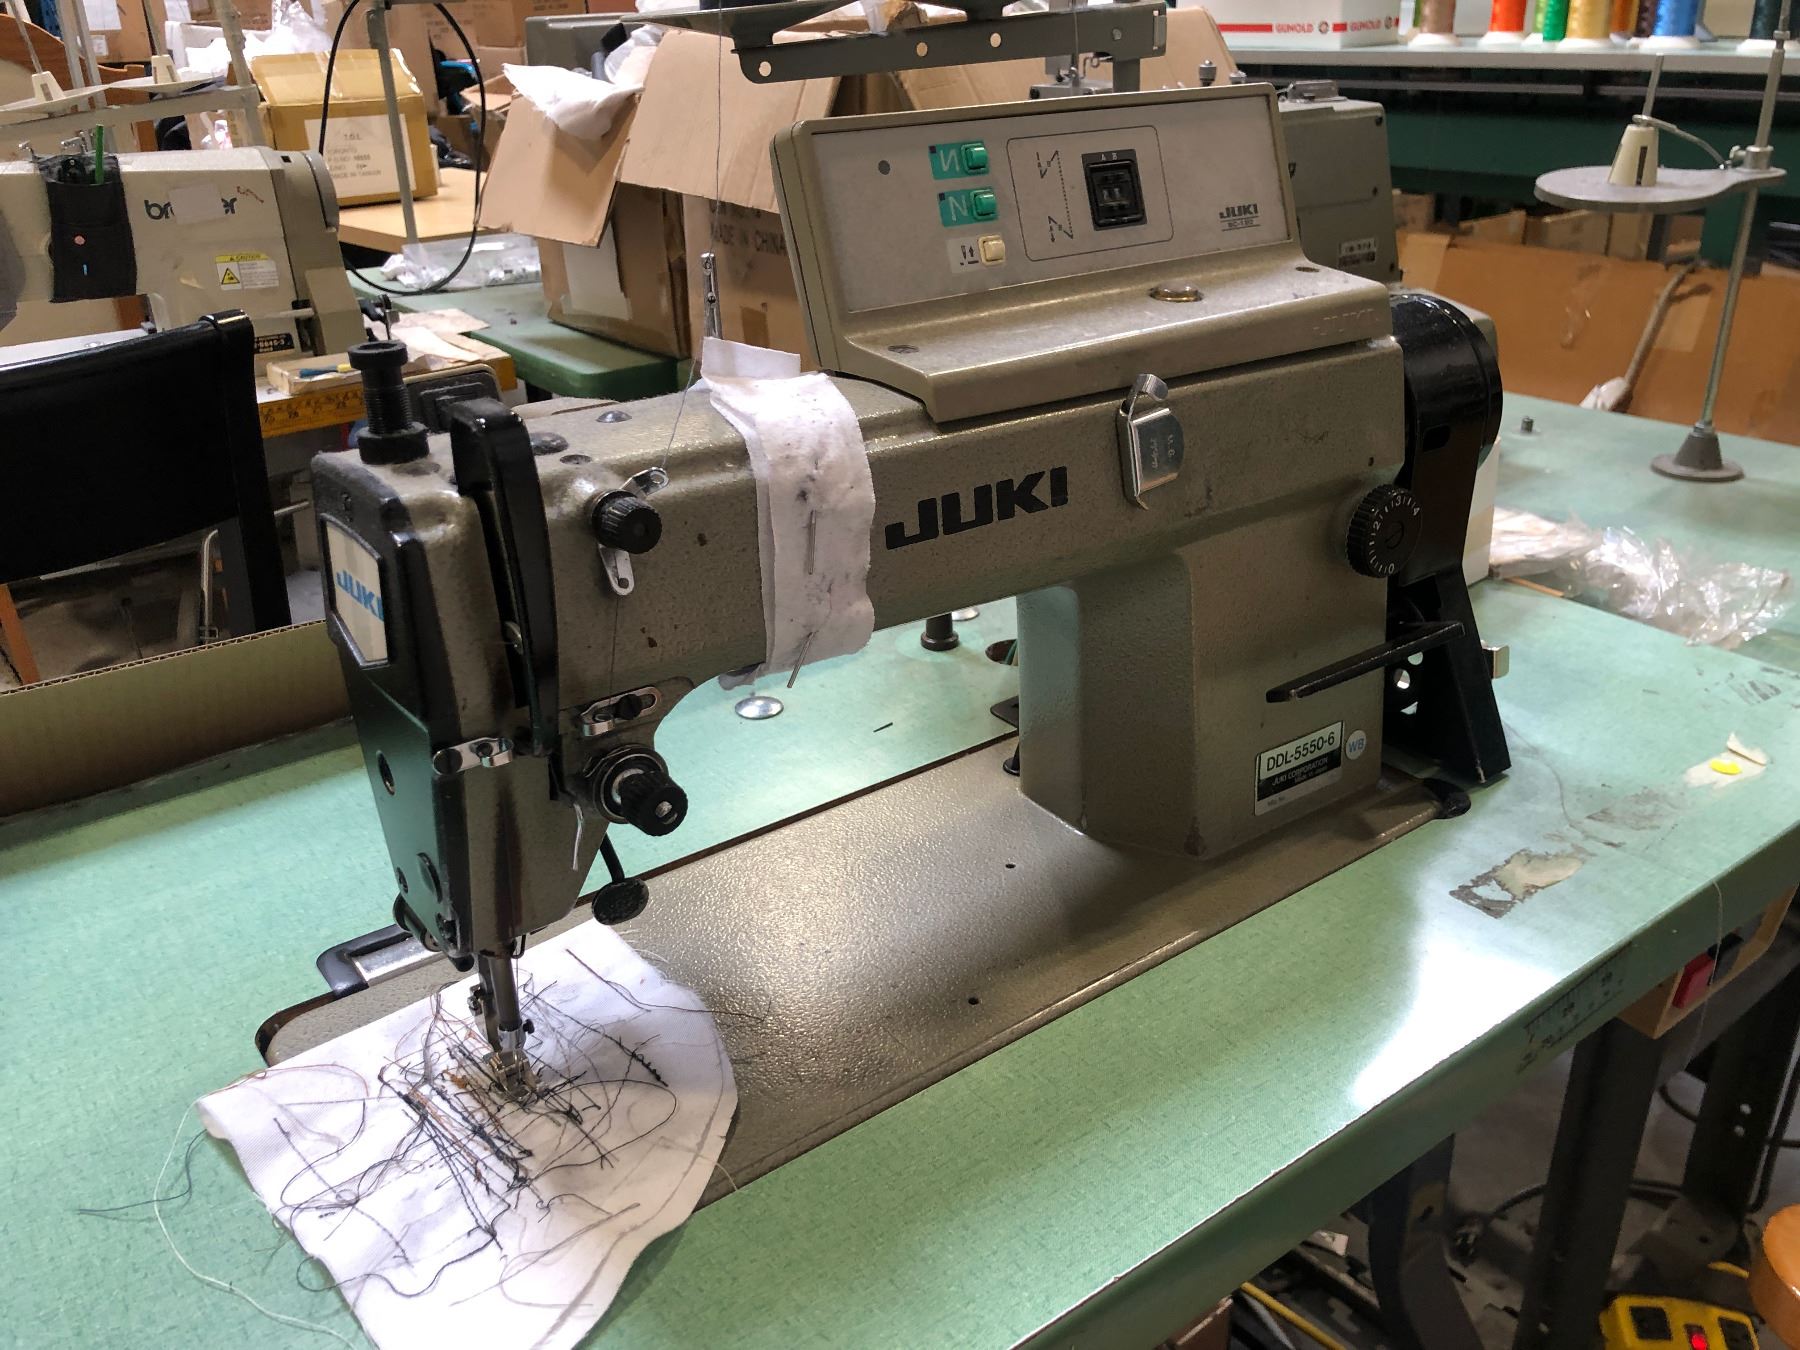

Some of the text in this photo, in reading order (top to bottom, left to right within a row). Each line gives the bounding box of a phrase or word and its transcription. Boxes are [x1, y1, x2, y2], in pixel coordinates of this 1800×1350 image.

[1219, 203, 1258, 219] JUKI
[885, 466, 1069, 550] JUKI
[1395, 495, 1402, 506] 3
[1266, 731, 1335, 772] DDL-5550-6
[1348, 738, 1365, 753] WB
